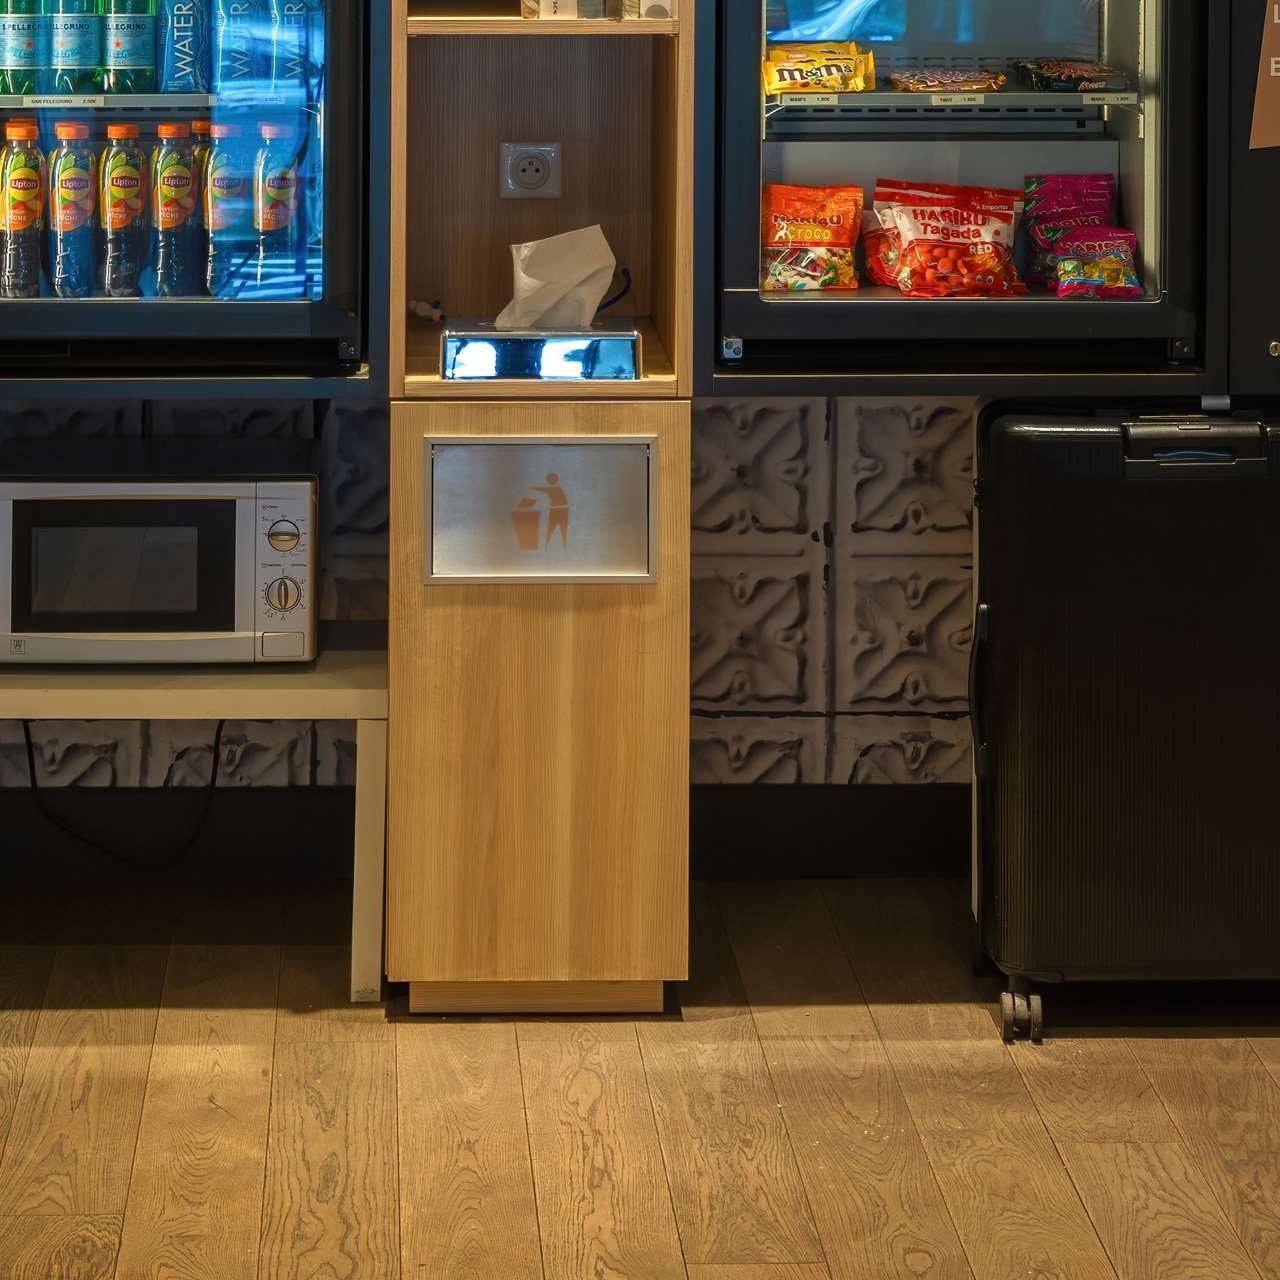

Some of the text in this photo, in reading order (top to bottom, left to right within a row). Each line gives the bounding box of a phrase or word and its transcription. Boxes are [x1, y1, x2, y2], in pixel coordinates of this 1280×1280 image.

[174, 2, 194, 78] WATER
[230, 2, 251, 78] WATER
[284, 2, 304, 78] WATER
[11, 180, 38, 190] Lipton
[113, 178, 138, 188] Lipton
[164, 178, 190, 186] Lipton
[920, 222, 982, 241] Tagada
[968, 244, 993, 254] RED
